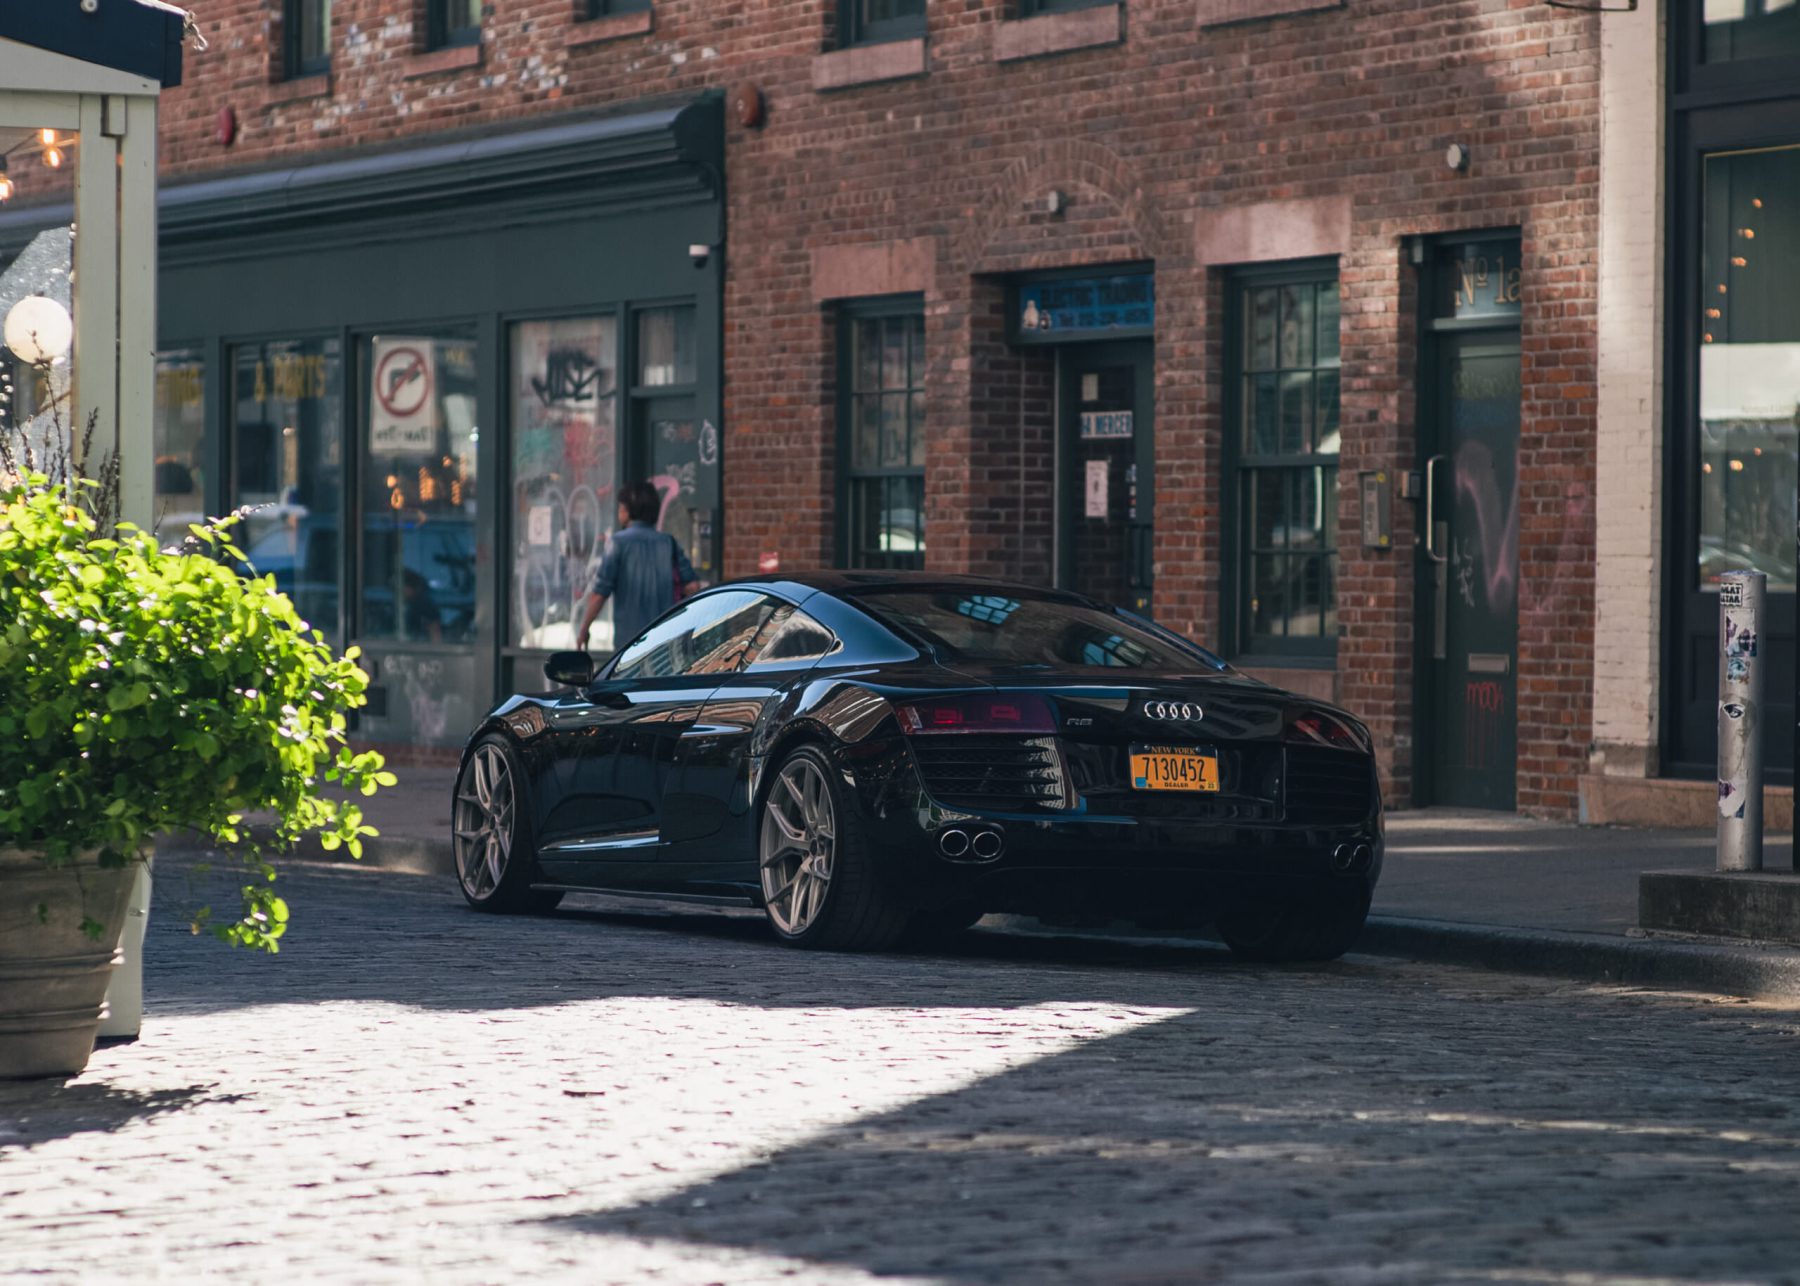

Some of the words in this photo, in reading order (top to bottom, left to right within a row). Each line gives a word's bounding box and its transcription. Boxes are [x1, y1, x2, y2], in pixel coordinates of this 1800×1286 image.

[1151, 745, 1172, 754] NEW
[1173, 746, 1196, 755] YORK
[1142, 756, 1206, 782] 7130452
